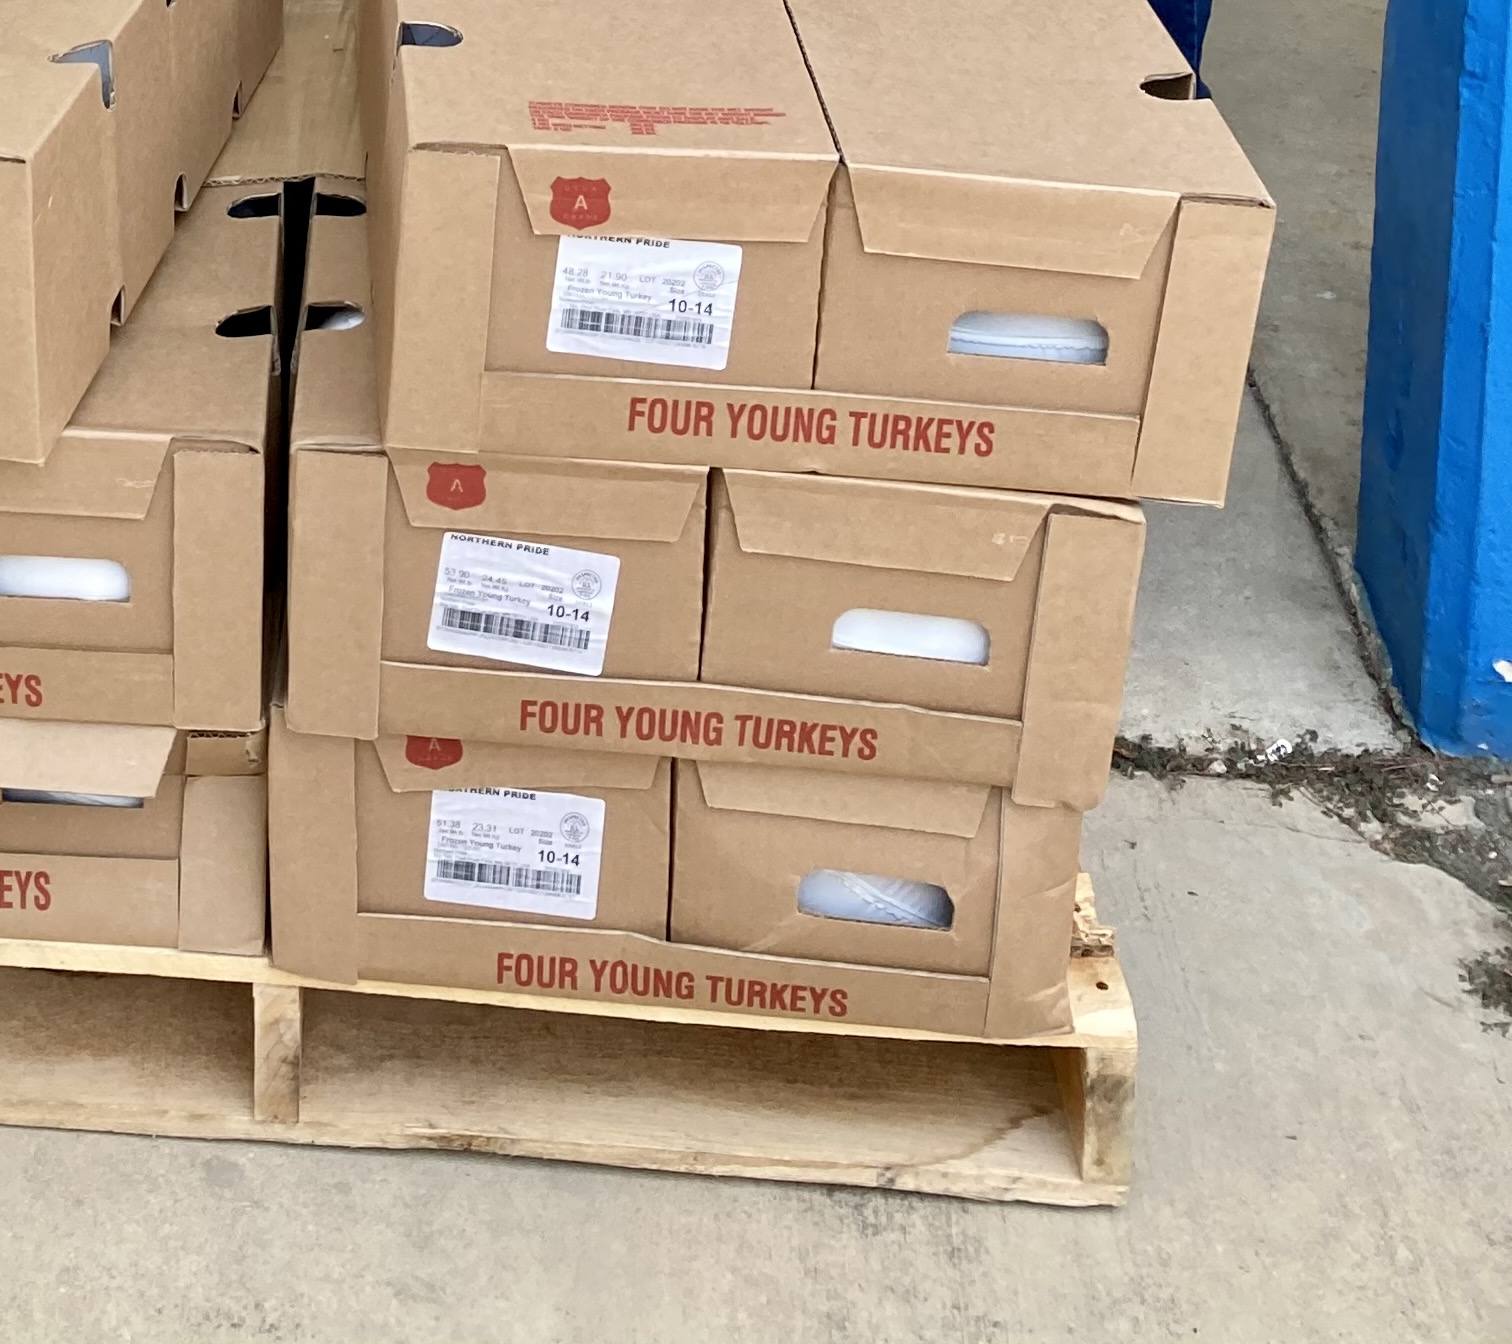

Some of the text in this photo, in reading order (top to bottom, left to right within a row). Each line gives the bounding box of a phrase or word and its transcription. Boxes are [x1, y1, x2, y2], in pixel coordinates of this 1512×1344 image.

[574, 194, 588, 210] A
[636, 237, 671, 249] PRIDE
[562, 267, 589, 278] 48.28
[600, 269, 628, 282] 21.90
[639, 275, 657, 284] LOT
[567, 284, 652, 302] Frozen Young Turkey
[668, 298, 714, 317] 10-14
[628, 397, 996, 458] FOUR YOUNG TURKEYS
[449, 478, 464, 493] A
[450, 533, 551, 556] NORTHERN PRIDE
[518, 579, 536, 589] LOT
[448, 585, 532, 607] Frozen Young Turkey
[546, 604, 591, 623] 10-14
[520, 699, 879, 762] FOUR YOUNG TURKEYS
[429, 738, 441, 752] A
[503, 790, 537, 801] PRIDE
[537, 849, 581, 867] 10-14
[497, 952, 849, 1018] FOUR YOUNG TURKEYS
